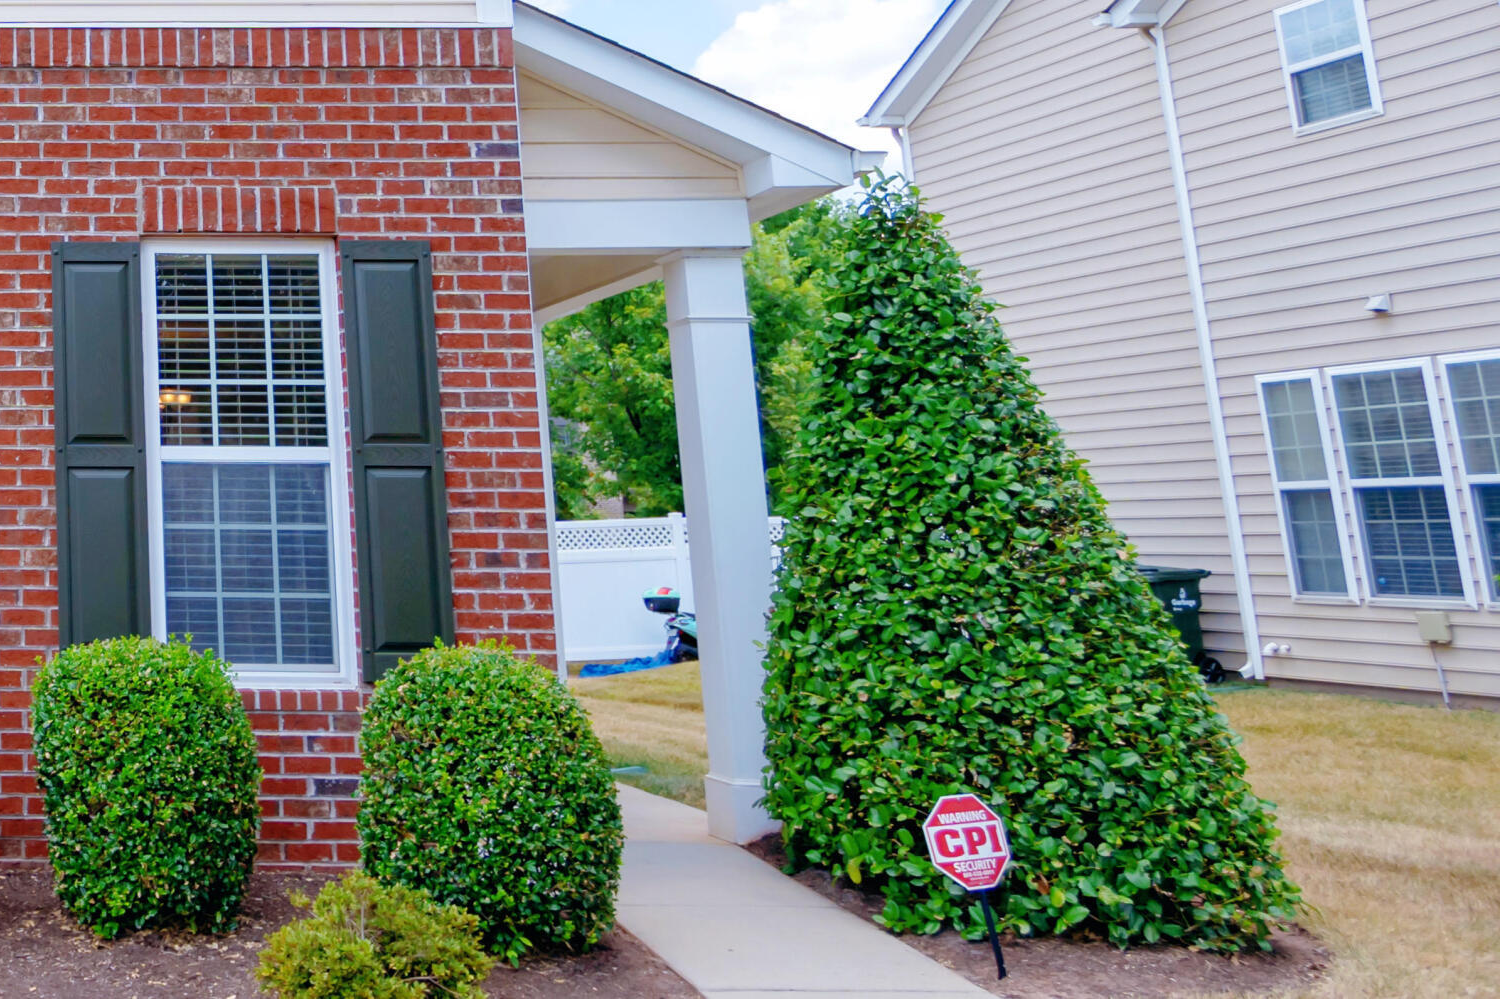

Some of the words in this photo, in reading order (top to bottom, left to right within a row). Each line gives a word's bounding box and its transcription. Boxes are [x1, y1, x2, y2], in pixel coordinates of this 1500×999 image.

[937, 810, 987, 824] WARNING
[934, 824, 1003, 858] CPI
[954, 858, 997, 873] SECURITY
